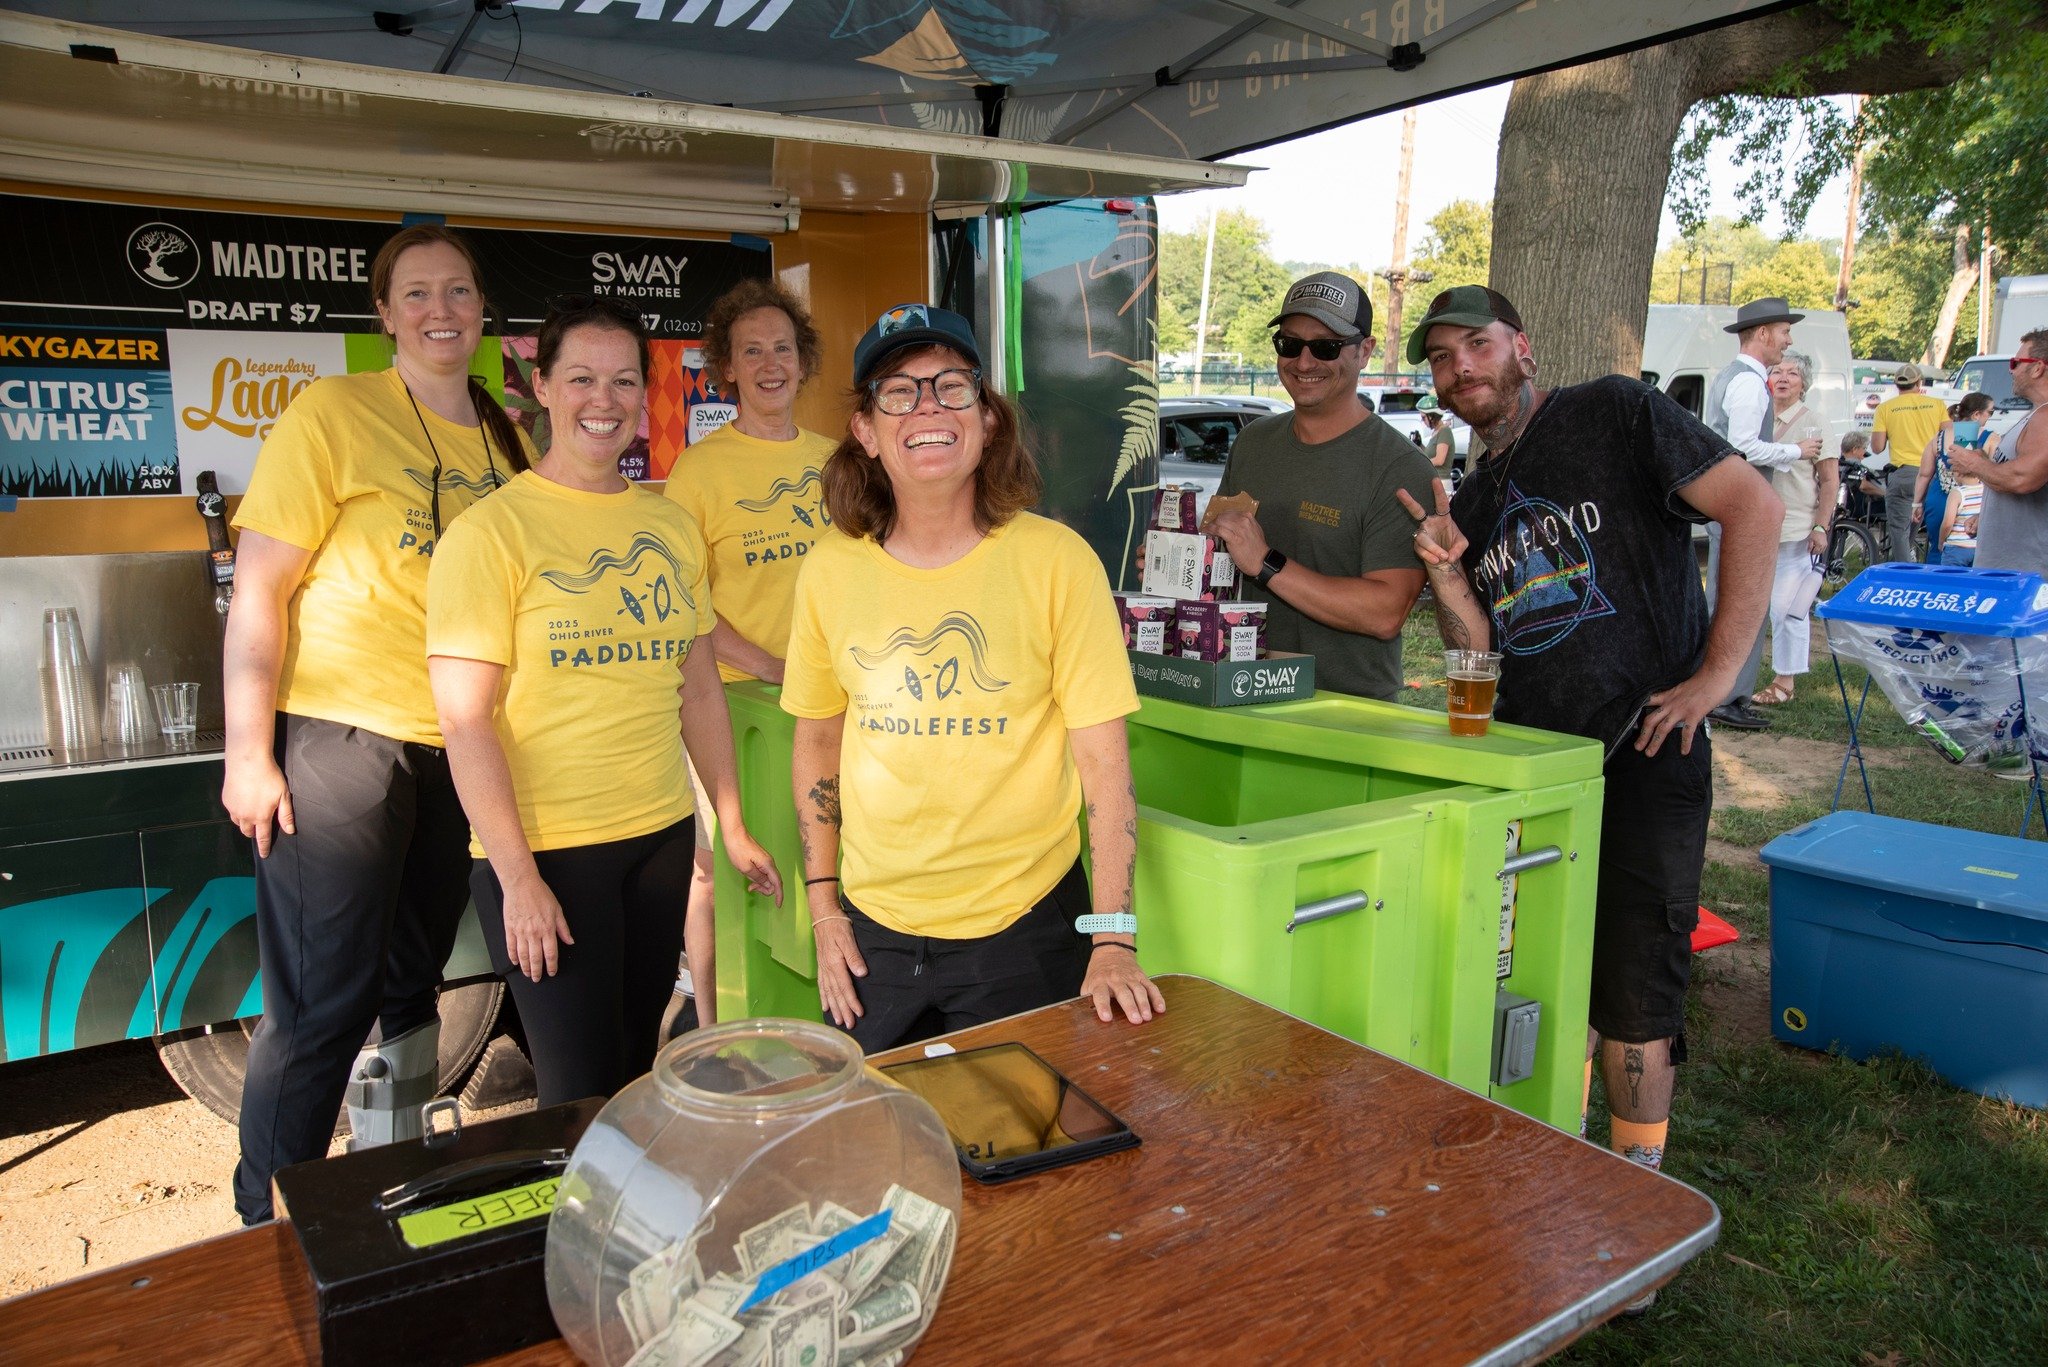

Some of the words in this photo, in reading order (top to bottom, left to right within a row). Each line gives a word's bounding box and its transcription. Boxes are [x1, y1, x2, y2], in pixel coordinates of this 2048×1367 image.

[211, 241, 369, 283] MADTREE
[592, 251, 688, 285] SWAY
[593, 285, 611, 295] BY
[617, 286, 681, 297] MADTREE
[1304, 284, 1344, 302] MADTREE
[188, 299, 282, 322] DRAFT
[290, 301, 321, 325] $7
[664, 319, 702, 333] (12oz)
[246, 357, 316, 377] legendary
[0, 379, 150, 411] CITRUS
[696, 409, 732, 422] SWAY
[1, 412, 153, 441] WHEAT
[619, 457, 644, 467] 4.5%
[140, 465, 175, 477] 5.0%
[621, 469, 642, 478] ABV
[141, 477, 172, 490] ABV
[407, 508, 433, 520] 2025
[1300, 500, 1342, 520] MADTREE
[406, 518, 433, 531] OHIO
[1520, 501, 1601, 561] FLOYD
[742, 529, 764, 539] 2025
[743, 537, 766, 547] OHIO
[768, 531, 790, 541] RIVER
[744, 540, 815, 567] PADD
[1186, 558, 1196, 591] SWAY
[1876, 587, 1961, 604] BOTTLES
[1869, 595, 1920, 609] CANS
[1921, 599, 1977, 614] ONLY
[548, 619, 579, 629] 2025
[1141, 626, 1162, 635] SWAY
[549, 631, 581, 641] OHIO
[584, 627, 614, 638] RIVER
[1234, 631, 1254, 640] SWAY
[1137, 664, 1158, 682] DAY
[1161, 667, 1193, 687] AWAY
[1254, 666, 1300, 689] SWAY
[1253, 688, 1263, 697] BY
[1264, 686, 1296, 695] MADTREE
[448, 1183, 558, 1231] BEER
[786, 1237, 838, 1279] TIPS
